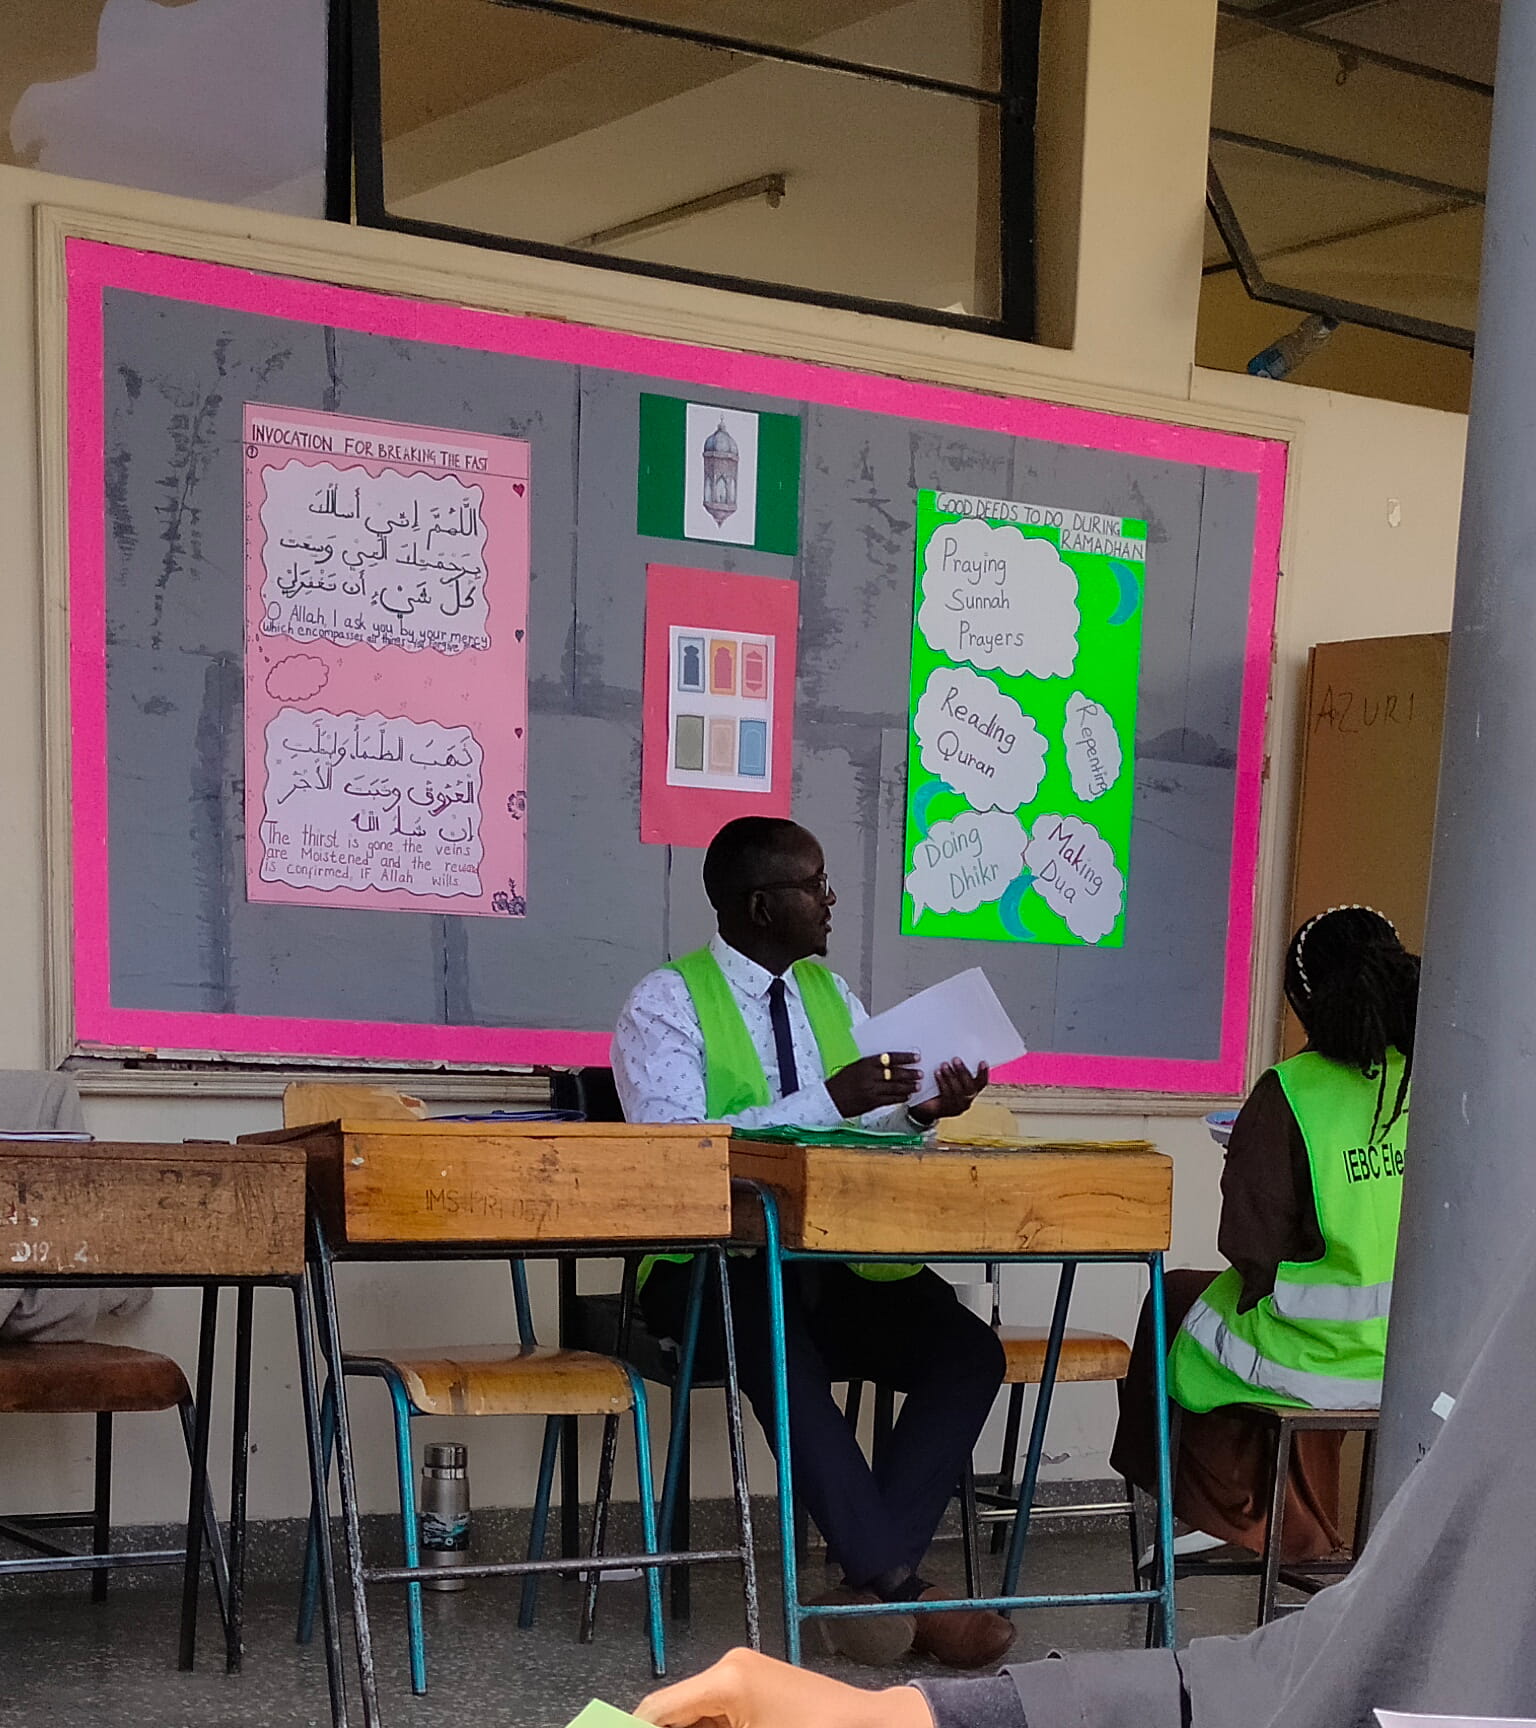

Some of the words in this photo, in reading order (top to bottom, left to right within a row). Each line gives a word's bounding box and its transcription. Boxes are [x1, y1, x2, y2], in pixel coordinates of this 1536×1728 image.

[252, 424, 332, 452] INVOCATION
[345, 438, 373, 456] FOR
[378, 443, 436, 464] BREAKING
[440, 451, 460, 468] THE
[465, 455, 488, 471] FAST
[936, 492, 973, 517] GOOD
[976, 496, 1019, 521] DEEDS
[1024, 506, 1042, 525] TO
[1044, 510, 1064, 528] DO
[1072, 513, 1121, 537] DURING
[942, 537, 1007, 585] Praying
[1061, 529, 1145, 560] RAMADHAN
[944, 588, 1010, 611] Sunnah
[263, 621, 294, 635] which
[297, 625, 364, 643] encompasses
[267, 601, 282, 621] O
[343, 612, 366, 630] ask
[372, 623, 393, 638] you
[400, 619, 415, 643] by
[419, 630, 447, 646] your
[450, 632, 488, 649] mercy
[959, 620, 1024, 654] Prayers
[940, 687, 1017, 754] Reading
[937, 730, 996, 779] Quran
[1075, 704, 1108, 796] Repenting
[264, 820, 291, 845] The
[302, 823, 340, 849] thirst
[348, 838, 359, 849] is
[402, 837, 423, 854] the
[435, 845, 471, 857] veins
[266, 847, 288, 860] are
[300, 847, 369, 866] Moistened
[380, 856, 401, 869] and
[411, 855, 432, 871] the
[925, 828, 983, 869] Doing
[1047, 821, 1104, 897] Making
[265, 860, 277, 873] is
[380, 868, 414, 884] Allah
[949, 858, 999, 900] Dhikr
[1039, 859, 1077, 904] Dua
[1342, 1146, 1382, 1184] IEBC
